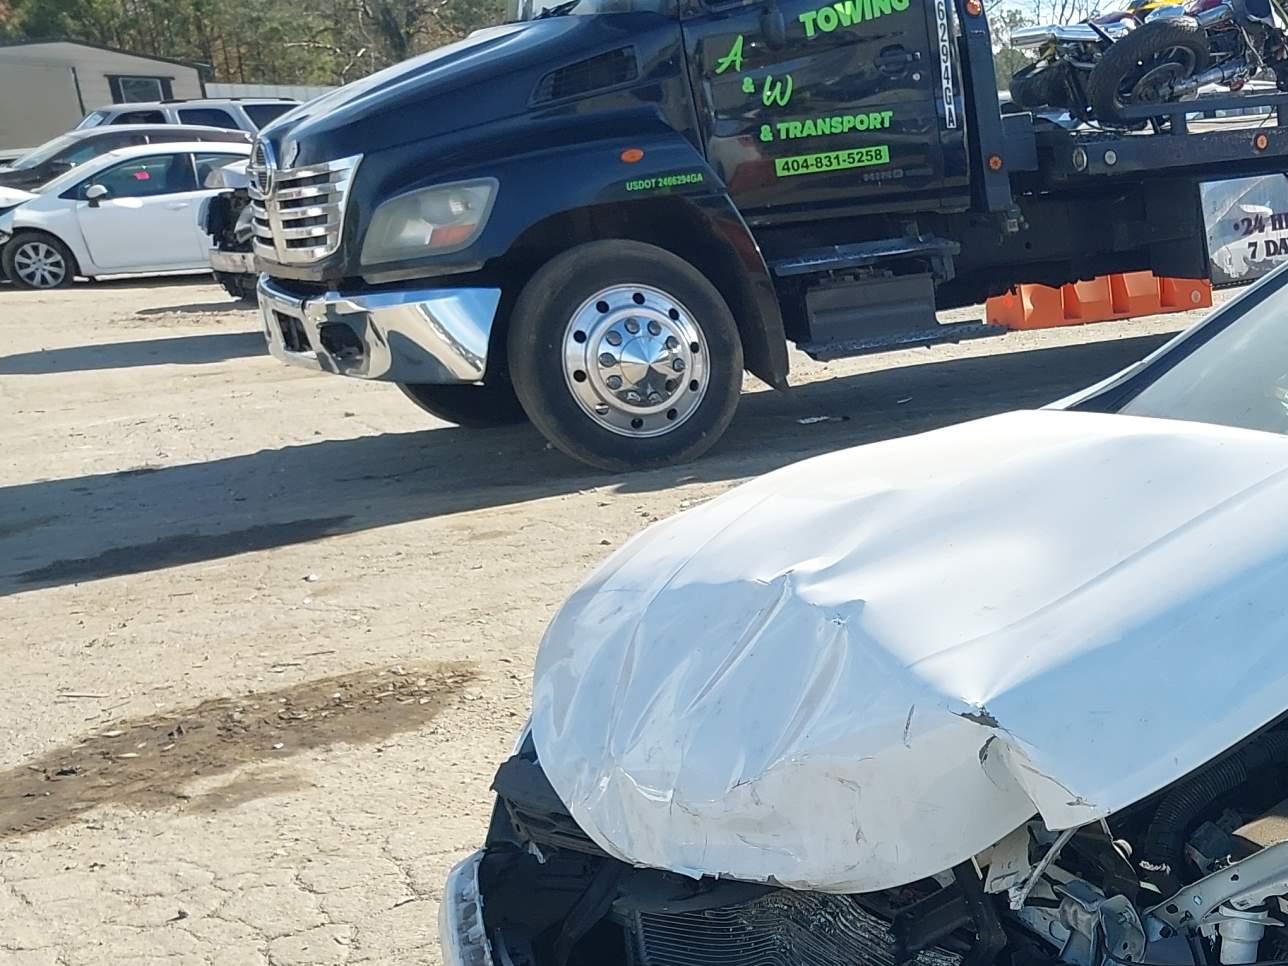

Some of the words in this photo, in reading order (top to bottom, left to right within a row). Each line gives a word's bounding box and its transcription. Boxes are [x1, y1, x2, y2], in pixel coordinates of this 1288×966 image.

[715, 35, 743, 74] A
[742, 77, 755, 93] &
[763, 75, 793, 106] W
[760, 125, 773, 141] &
[777, 111, 893, 139] TRANSPORT
[782, 149, 883, 173] 404-831-5258
[626, 179, 656, 191] USDOT
[1248, 241, 1258, 259] 7
